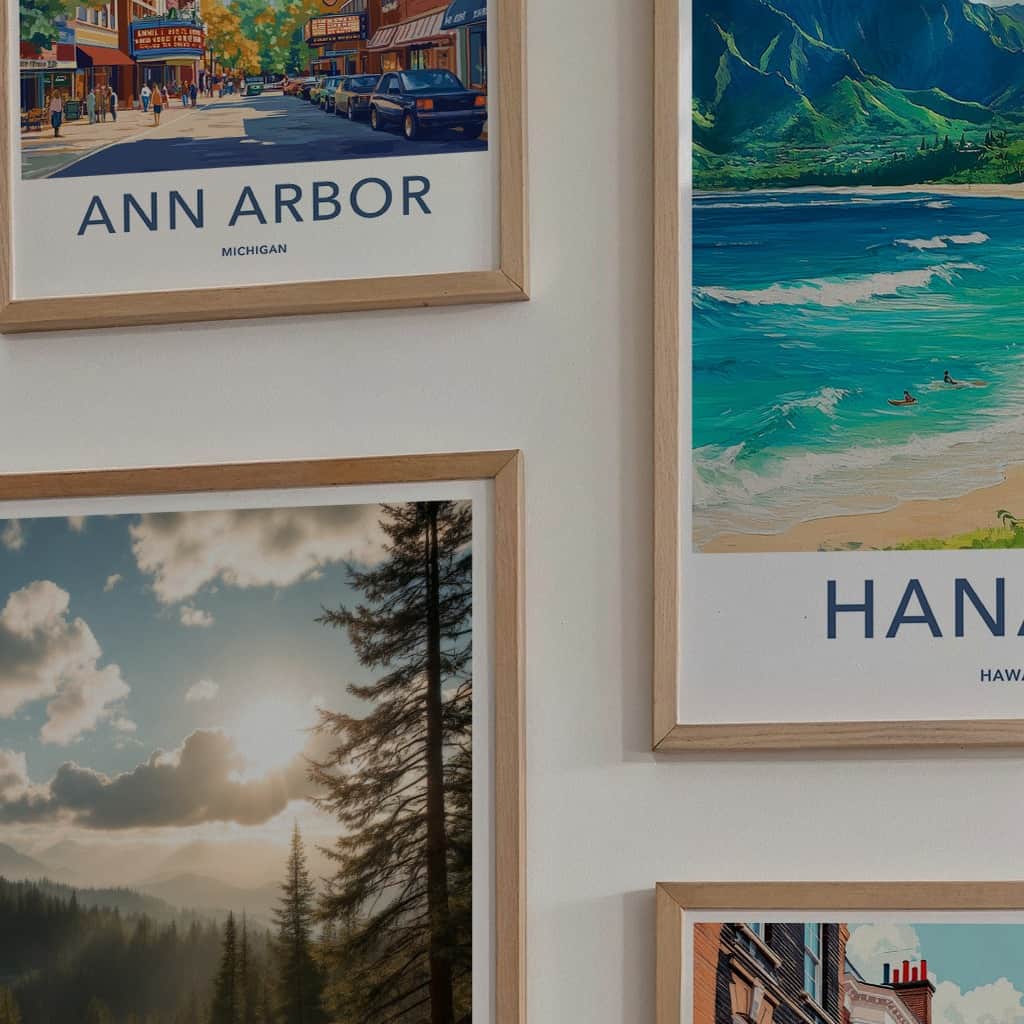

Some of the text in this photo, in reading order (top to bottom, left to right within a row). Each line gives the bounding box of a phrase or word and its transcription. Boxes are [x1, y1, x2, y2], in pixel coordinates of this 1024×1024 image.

[77, 175, 432, 237] ANN ARBOR
[221, 244, 288, 257] MICHIGAN
[826, 577, 1024, 640] HAN
[980, 668, 1024, 682] HAW
